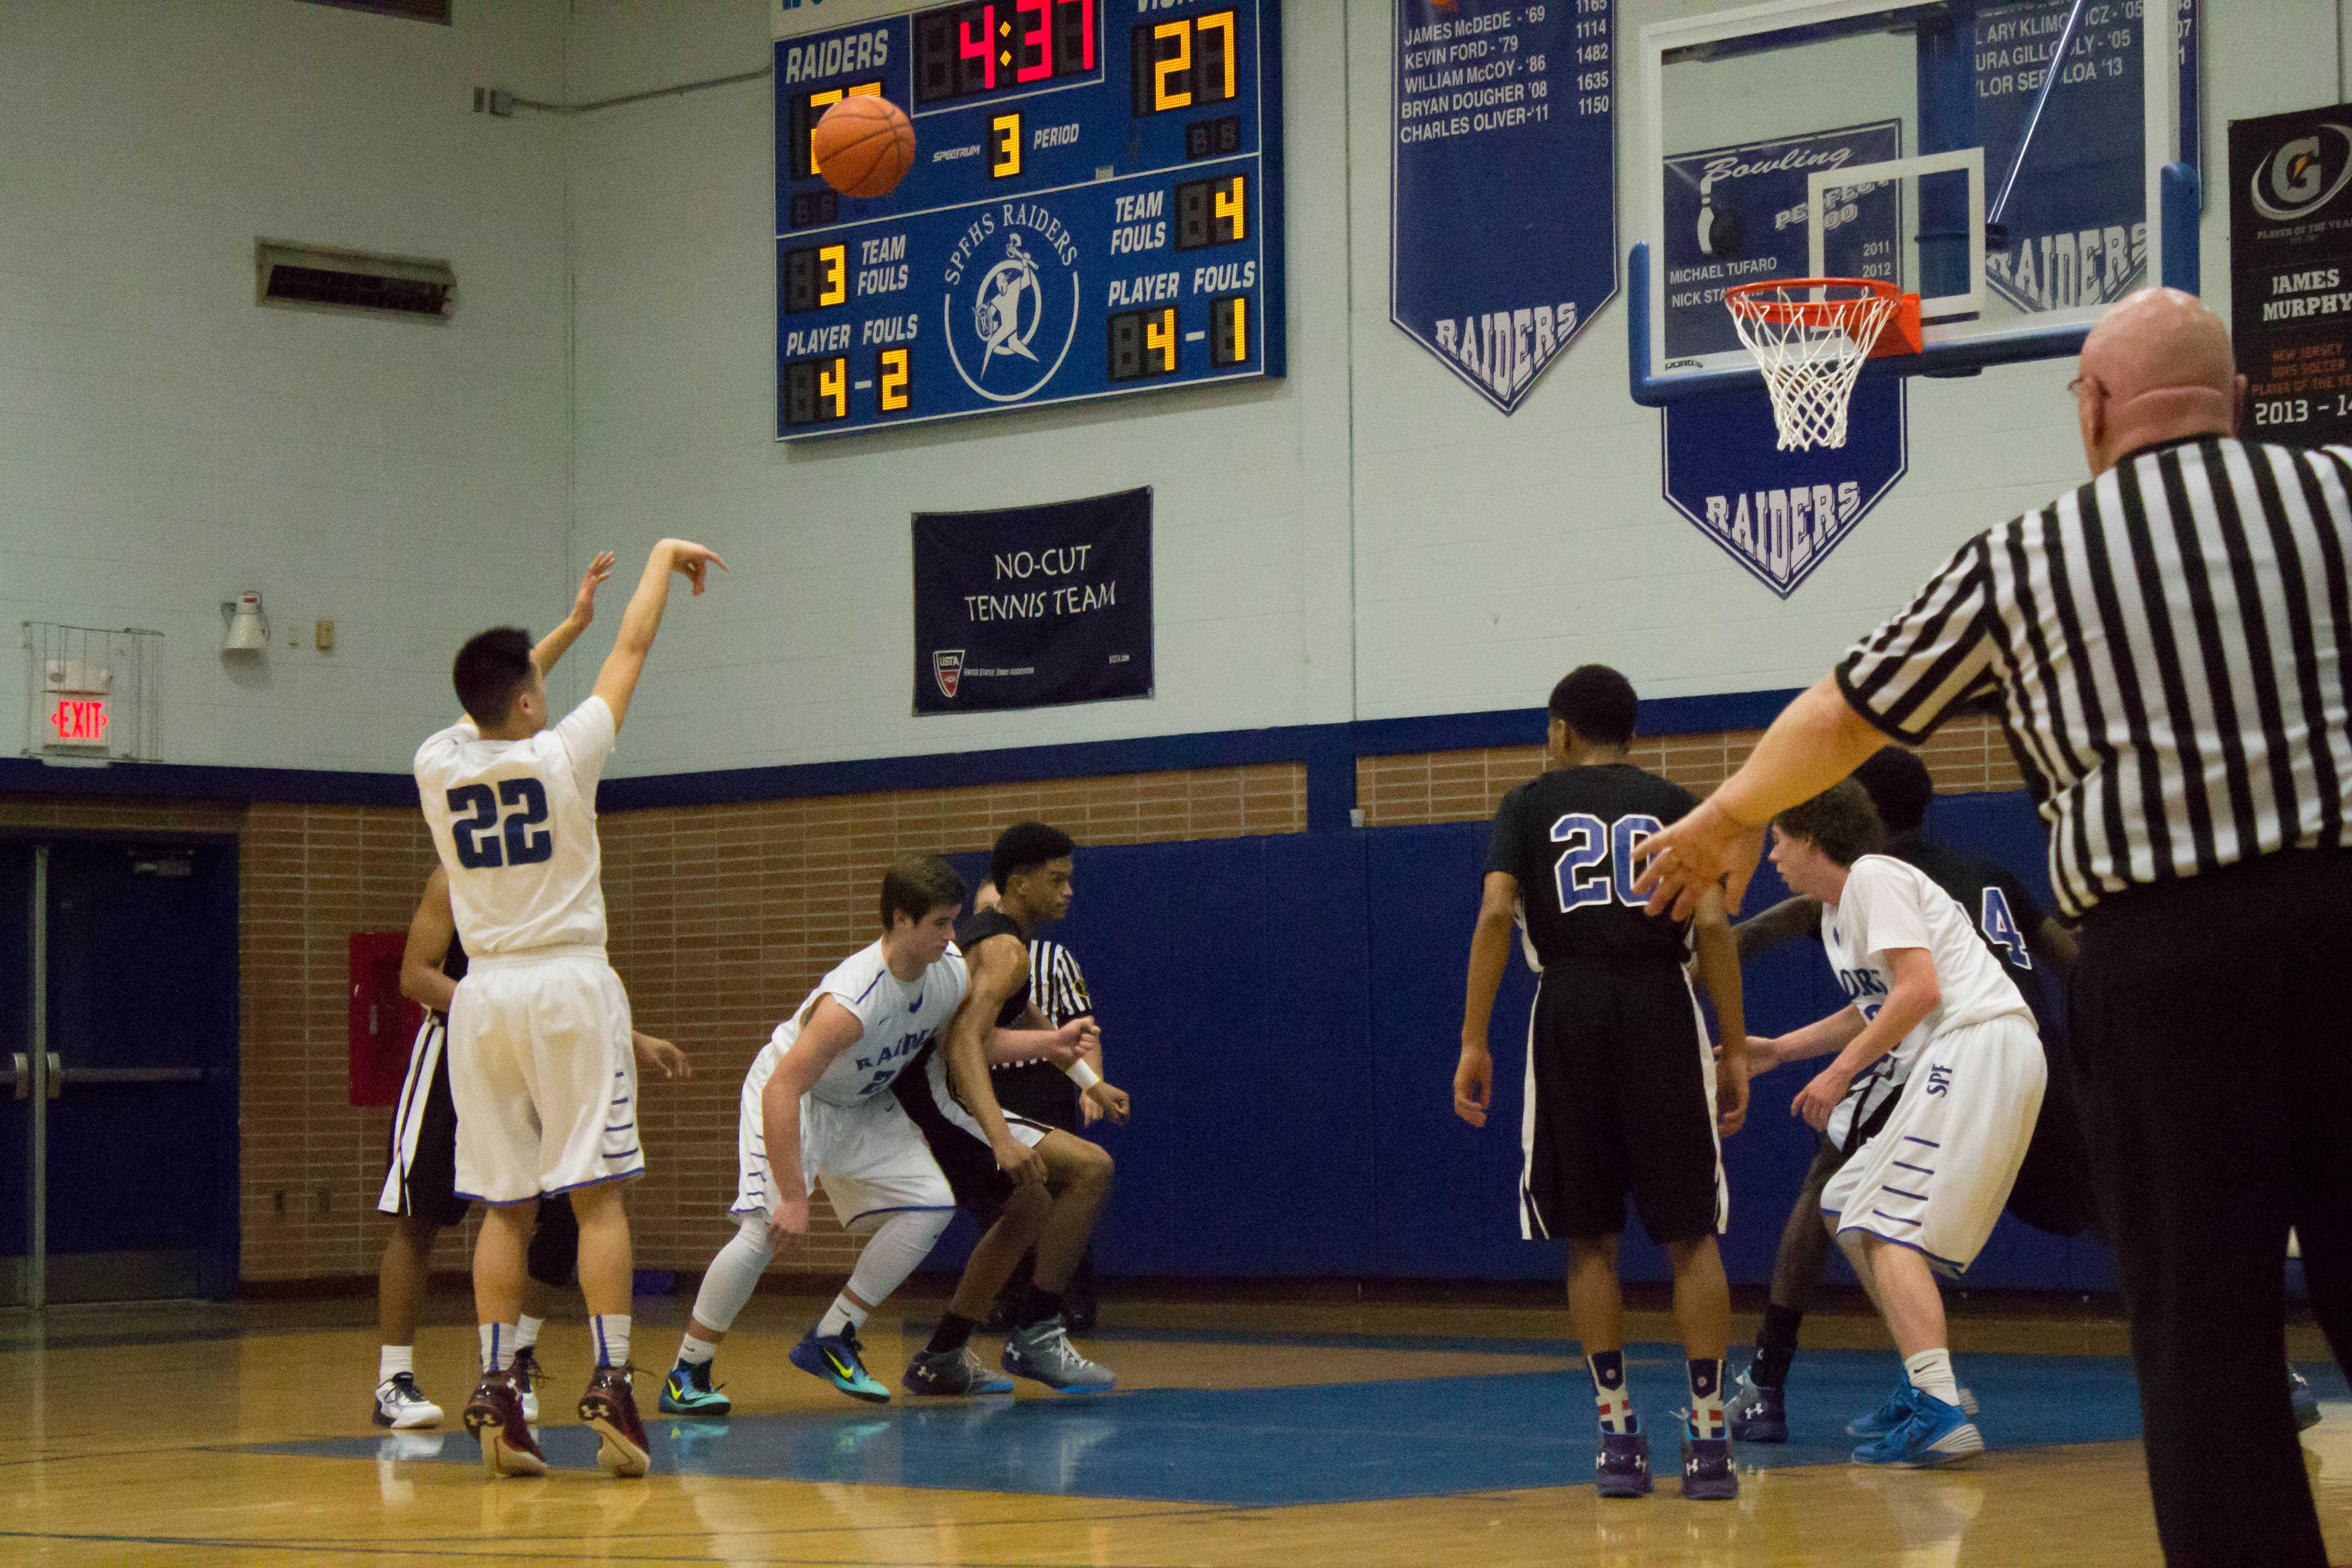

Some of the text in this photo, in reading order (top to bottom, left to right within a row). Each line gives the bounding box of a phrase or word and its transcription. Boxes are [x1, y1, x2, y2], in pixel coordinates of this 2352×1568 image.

[1404, 23, 1452, 46] JAMES
[1455, 11, 1511, 37] McDEDE
[1526, 5, 1545, 23] '69
[1576, 19, 1607, 39] 1114
[2108, 29, 2131, 48] '05
[786, 29, 889, 84] RAIDERS
[960, 0, 1093, 89] 4:37
[1154, 11, 1235, 111] 27
[1405, 47, 1446, 70] KEVIN
[1450, 40, 1488, 62] FORD
[1499, 35, 1518, 53] '79
[1576, 43, 1609, 64] 1482
[1404, 69, 1464, 93] WILLIAM
[1467, 59, 1515, 84] McCOY
[1577, 71, 1609, 91] 1635
[2101, 58, 2123, 77] '13
[1401, 95, 1449, 119] BRYAN
[1453, 84, 1525, 111] DOUGHER
[1578, 96, 1609, 116] 1150
[993, 113, 1020, 178] 3
[1033, 123, 1080, 150] PERIOD
[1400, 117, 1470, 143] CHARLES
[1703, 148, 1853, 183] Bowling
[1115, 190, 1164, 223] TEAM
[1216, 176, 1244, 240] 4
[862, 235, 907, 266] TEAM
[945, 203, 1078, 286] SPFHS RAIDERS
[1110, 221, 1166, 255] FOULS
[1863, 239, 1890, 257] 2011
[820, 245, 846, 307] 3
[857, 264, 909, 297] FOULS
[1108, 260, 1256, 307] PLAYER FOULS
[1670, 257, 1777, 284] MICHAEL TUFARO
[1863, 262, 1891, 278] 2012
[2272, 269, 2340, 295] JAMES
[1672, 291, 1701, 308] NICK
[2263, 292, 2352, 322] MURPHY
[786, 313, 919, 357] PLAYER FOULS
[1435, 302, 1577, 401] RAIDERS
[2255, 399, 2309, 425] 2013
[1706, 481, 1861, 584] RAIDERS
[995, 544, 1092, 580] NO-CUT
[963, 580, 1116, 622] TENNIS TEAM
[939, 655, 960, 666] USTA
[58, 700, 103, 740] EXIT
[446, 777, 553, 869] 22
[1550, 813, 1664, 914] 20
[1926, 1063, 1953, 1098] SPF
